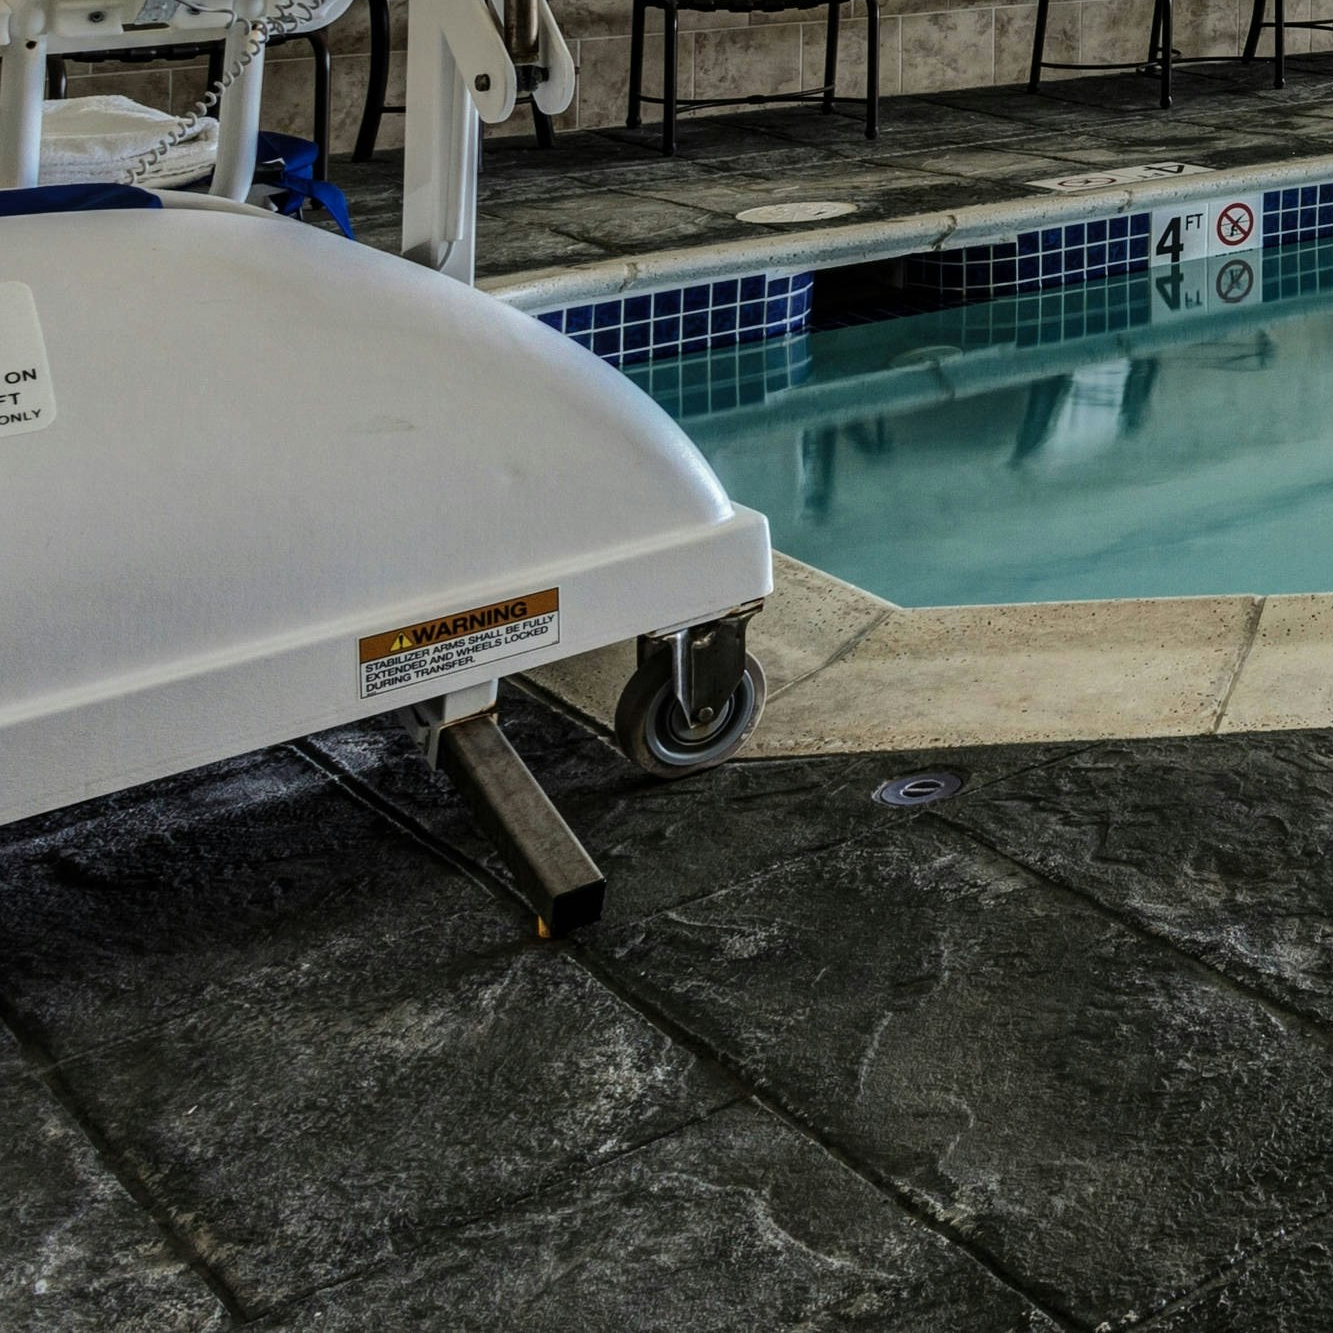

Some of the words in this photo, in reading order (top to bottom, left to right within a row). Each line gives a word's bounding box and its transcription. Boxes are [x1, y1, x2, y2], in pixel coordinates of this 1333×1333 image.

[1156, 217, 1184, 263] 4
[1186, 213, 1203, 231] FT
[4, 368, 37, 384] ON
[0, 409, 41, 425] ONLY
[365, 648, 430, 673] STABILIZER
[433, 639, 465, 654] ARMS
[468, 629, 503, 645] SHALL
[505, 623, 520, 635] BE
[523, 614, 555, 630] FULLY
[412, 601, 527, 644] WARNING
[366, 660, 427, 683] EXTENDED
[430, 652, 454, 666] AND
[456, 638, 502, 657] WHEELS
[504, 626, 549, 645] LOCKED
[367, 672, 412, 693] DURING
[414, 656, 476, 679] TRANSFER.
